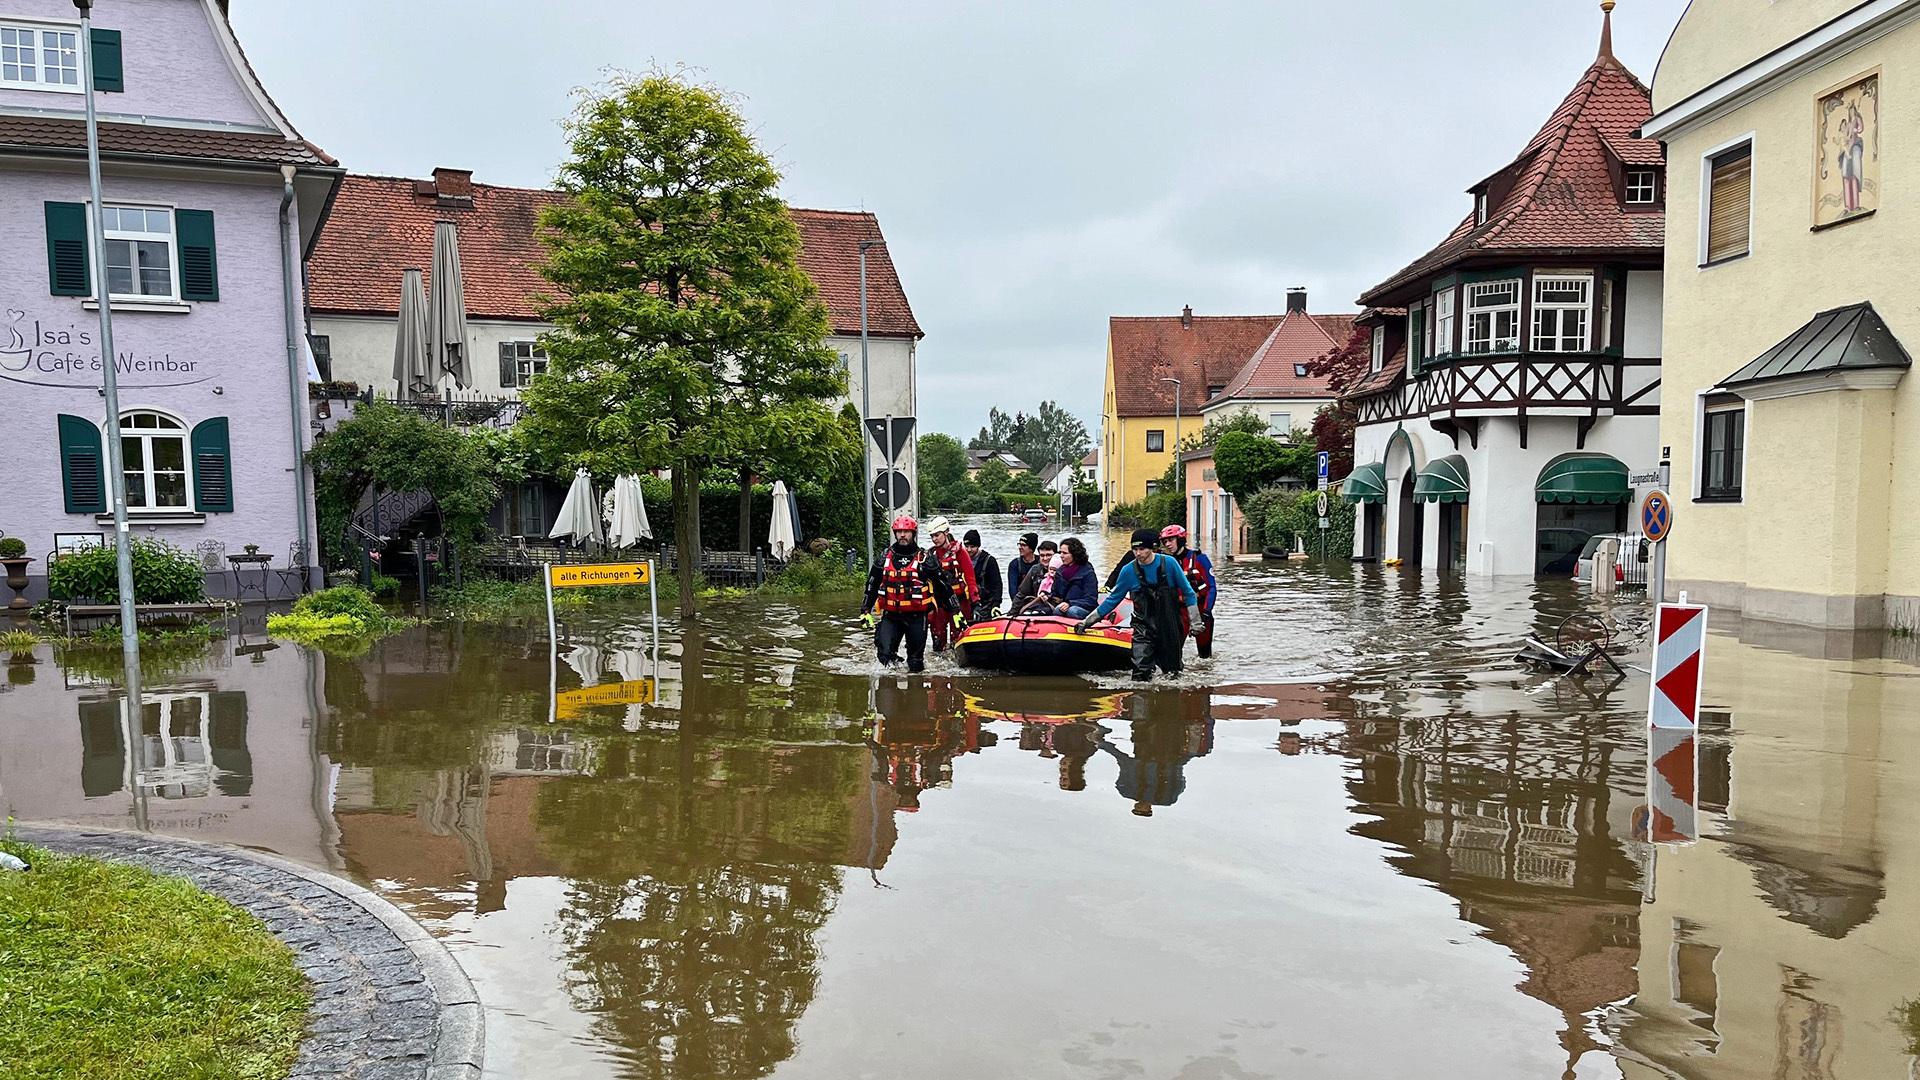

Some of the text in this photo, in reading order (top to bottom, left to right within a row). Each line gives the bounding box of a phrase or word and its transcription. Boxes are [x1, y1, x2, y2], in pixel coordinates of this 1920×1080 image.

[35, 320, 91, 347] Isa's
[37, 351, 198, 374] Café & Weinbar
[1320, 456, 1326, 474] P
[560, 571, 630, 580] alle Richtungen
